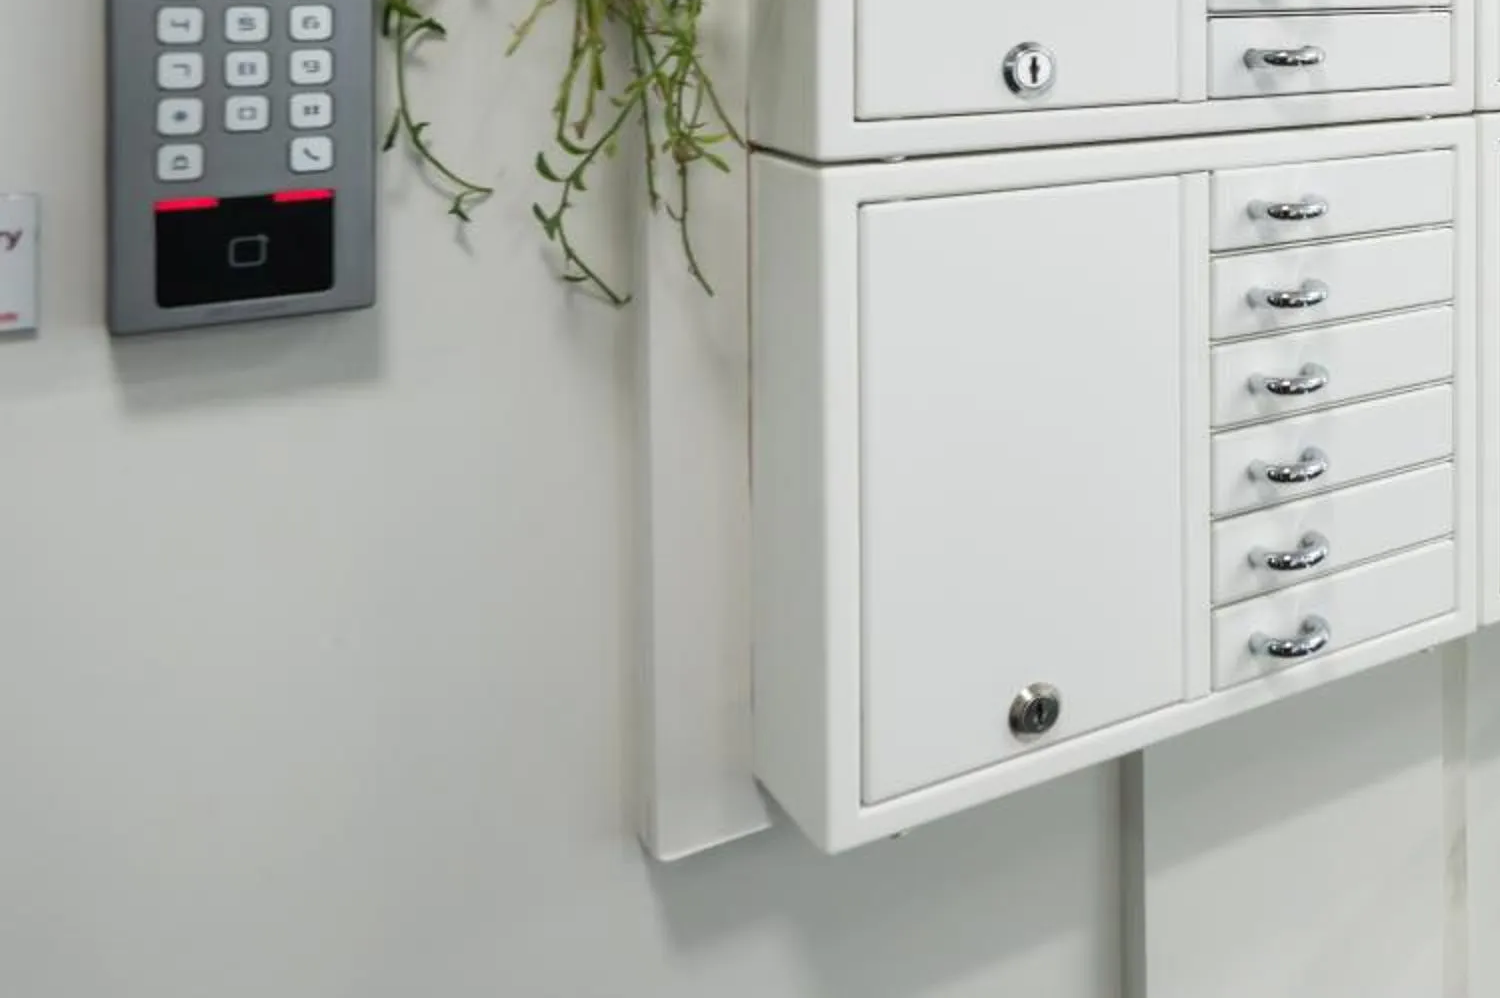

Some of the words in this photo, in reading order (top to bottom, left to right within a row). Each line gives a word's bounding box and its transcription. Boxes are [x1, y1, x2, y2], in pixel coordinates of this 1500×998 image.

[237, 15, 257, 32] 5
[302, 15, 321, 31] 6
[302, 59, 321, 74] 9
